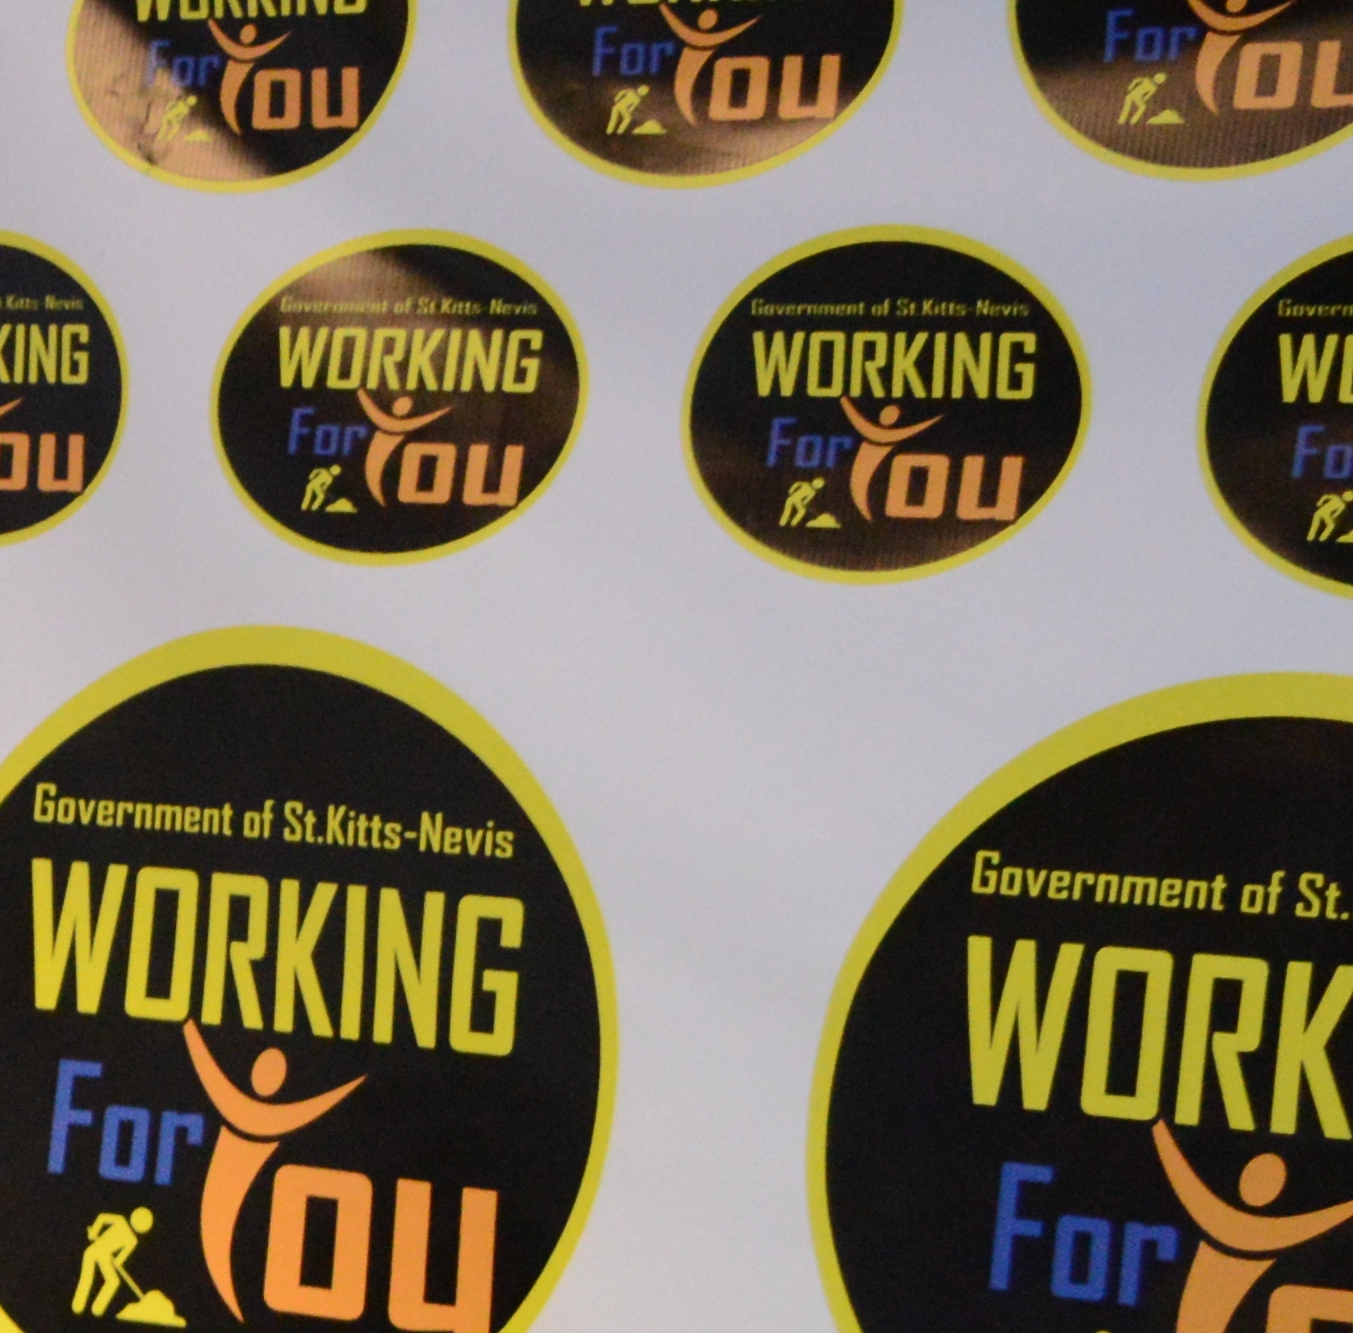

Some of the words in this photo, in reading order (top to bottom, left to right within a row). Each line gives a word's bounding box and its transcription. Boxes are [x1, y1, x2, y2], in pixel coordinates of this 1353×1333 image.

[279, 326, 543, 395] WORKING
[751, 331, 1037, 402] WORKING
[285, 407, 370, 457] For
[763, 416, 854, 469] For
[33, 782, 234, 837] Government
[243, 799, 275, 840] of
[966, 849, 1227, 914] Government
[1240, 869, 1286, 916] of
[31, 857, 525, 1057] WORKING
[965, 932, 1353, 1142] WORK
[48, 1059, 206, 1187] For
[986, 1162, 1182, 1307] For
